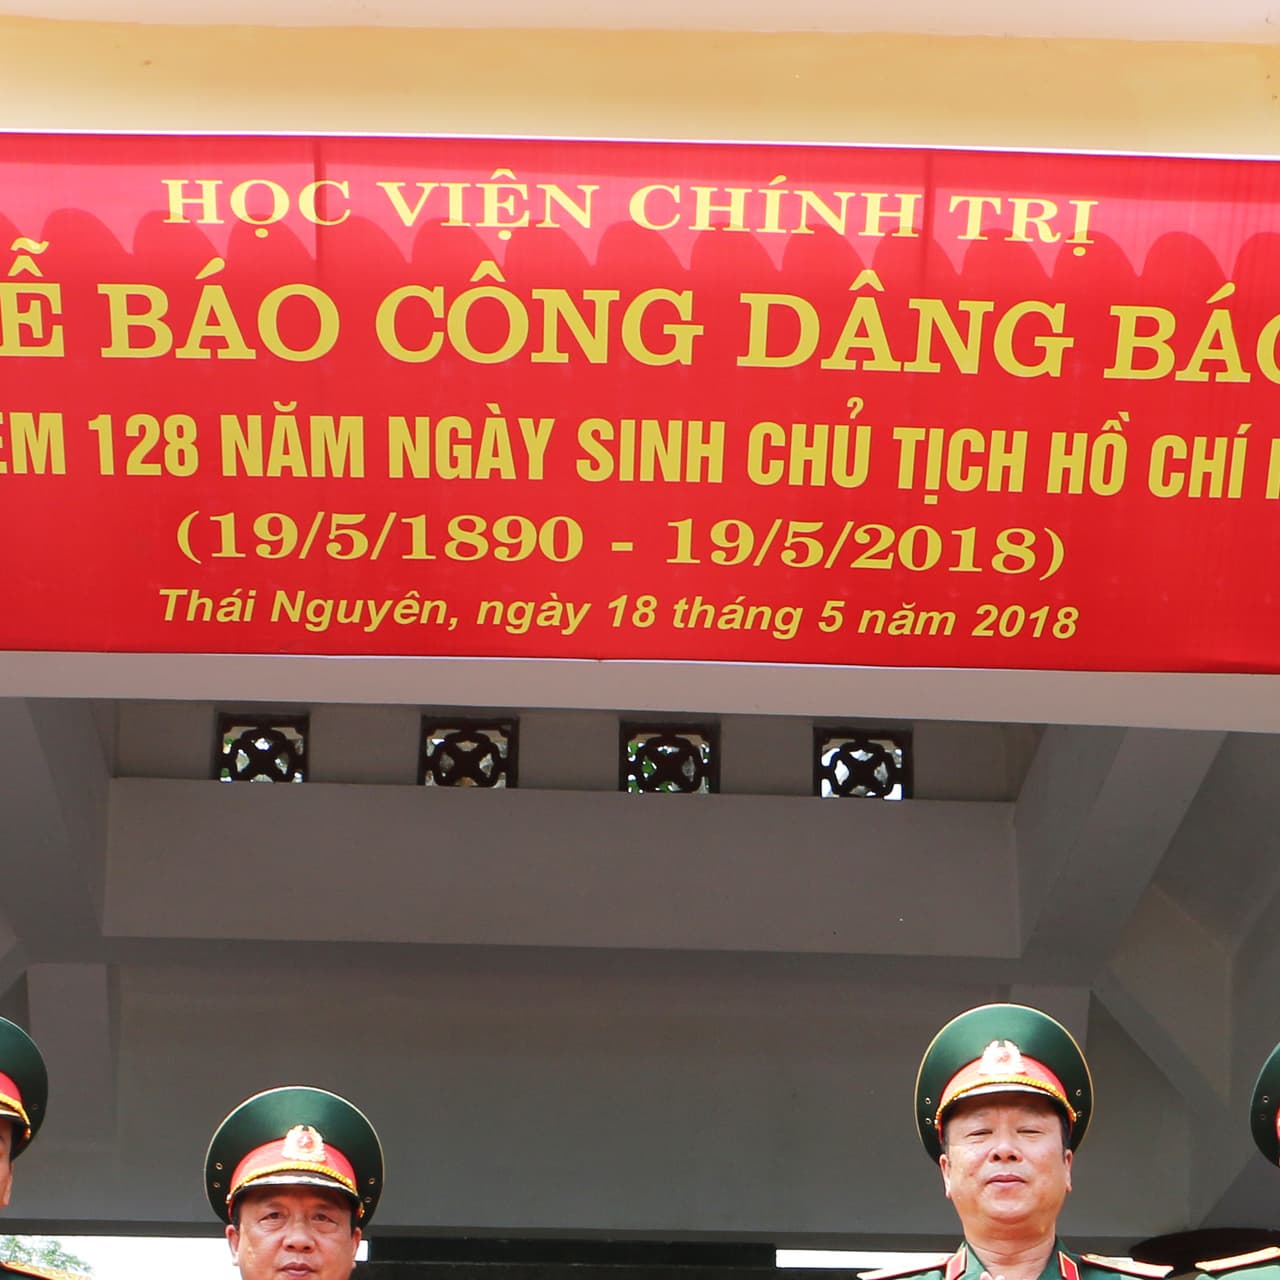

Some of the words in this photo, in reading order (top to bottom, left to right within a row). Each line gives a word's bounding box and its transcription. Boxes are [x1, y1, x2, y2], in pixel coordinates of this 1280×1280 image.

[163, 178, 351, 239] HỌC
[377, 168, 600, 240] VIỆN
[628, 175, 923, 238] CHÍNH
[950, 195, 1100, 257] TRỊ
[97, 256, 340, 362] BÁO
[376, 260, 705, 366] CÔNG
[736, 269, 1076, 378] DÂNG
[88, 413, 199, 477] 128
[221, 400, 365, 478] NĂM
[388, 402, 556, 480] NGÀY
[576, 418, 726, 484] SINH
[747, 396, 872, 489] CHỦ
[892, 426, 1028, 505] TỊCH
[1046, 411, 1131, 496] HỒ
[1149, 423, 1252, 499] CHÍ
[177, 511, 584, 564] (19/5/1890
[666, 518, 1066, 581] 19/5/2018)
[159, 588, 255, 623] Thái
[271, 590, 458, 633] Nguyên,
[476, 593, 592, 636] ngày
[609, 594, 658, 628] 18
[672, 594, 804, 640] tháng
[818, 600, 846, 633] 5
[858, 600, 956, 636] năm
[971, 604, 1079, 639] 2018
